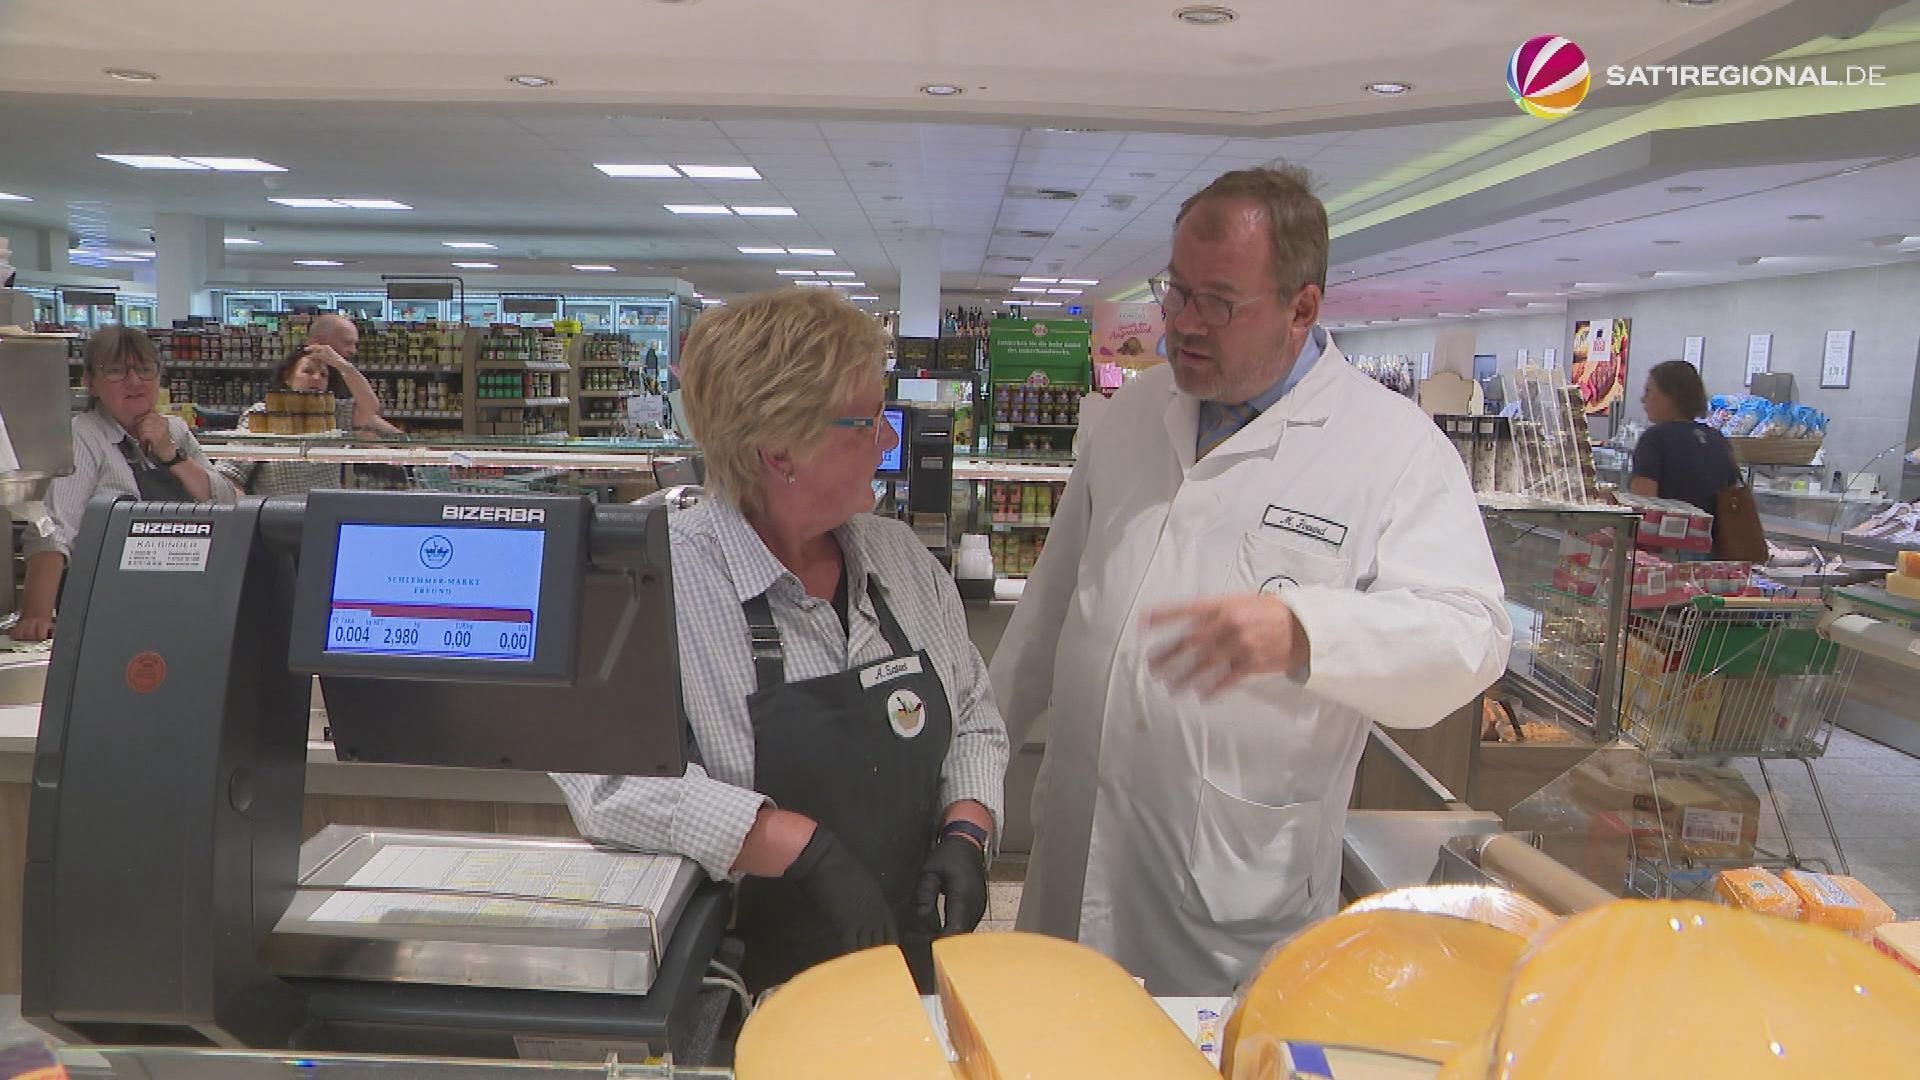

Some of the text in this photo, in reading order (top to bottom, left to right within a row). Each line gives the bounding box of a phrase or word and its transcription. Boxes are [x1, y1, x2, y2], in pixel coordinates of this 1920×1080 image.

[441, 504, 546, 524] BIZERBA
[131, 522, 211, 534] BIZERBA
[387, 576, 481, 587] SCHLEMMER-MARKT
[335, 626, 527, 651] 0,004 2,980 0,00 0,00
